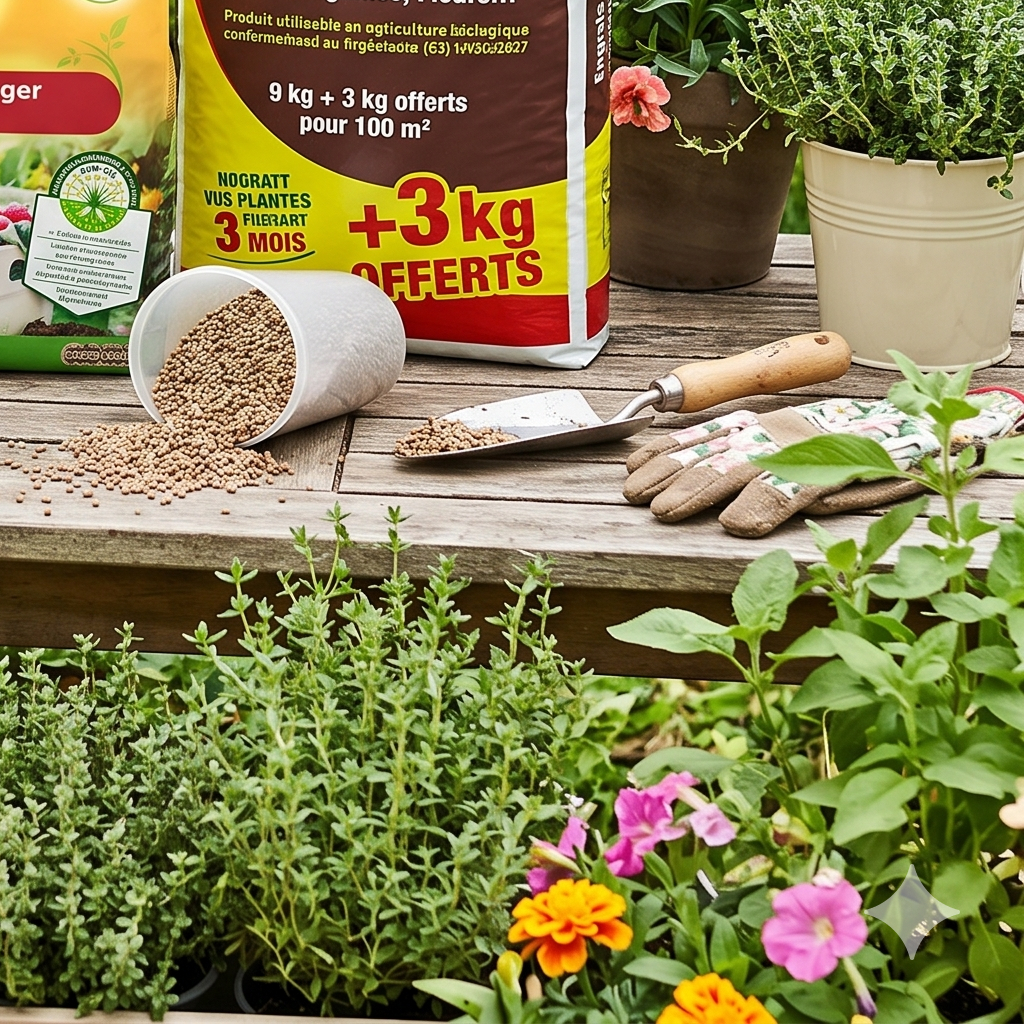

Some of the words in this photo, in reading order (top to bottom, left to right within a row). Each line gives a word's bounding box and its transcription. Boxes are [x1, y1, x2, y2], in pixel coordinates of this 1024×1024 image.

[224, 9, 273, 26] Produit
[344, 21, 361, 33] an
[322, 38, 339, 50] au
[269, 81, 282, 102] 9
[288, 83, 314, 109] kg
[320, 91, 335, 106] +
[342, 87, 355, 108] 3
[361, 88, 388, 115] kg
[394, 91, 468, 113] offerts
[299, 115, 348, 135] pour
[355, 116, 394, 138] 100
[217, 171, 290, 189] NOGRATT
[203, 189, 233, 207] VUS
[237, 192, 312, 209] PLANTES
[214, 211, 241, 253] 3
[248, 232, 307, 253] MOIS
